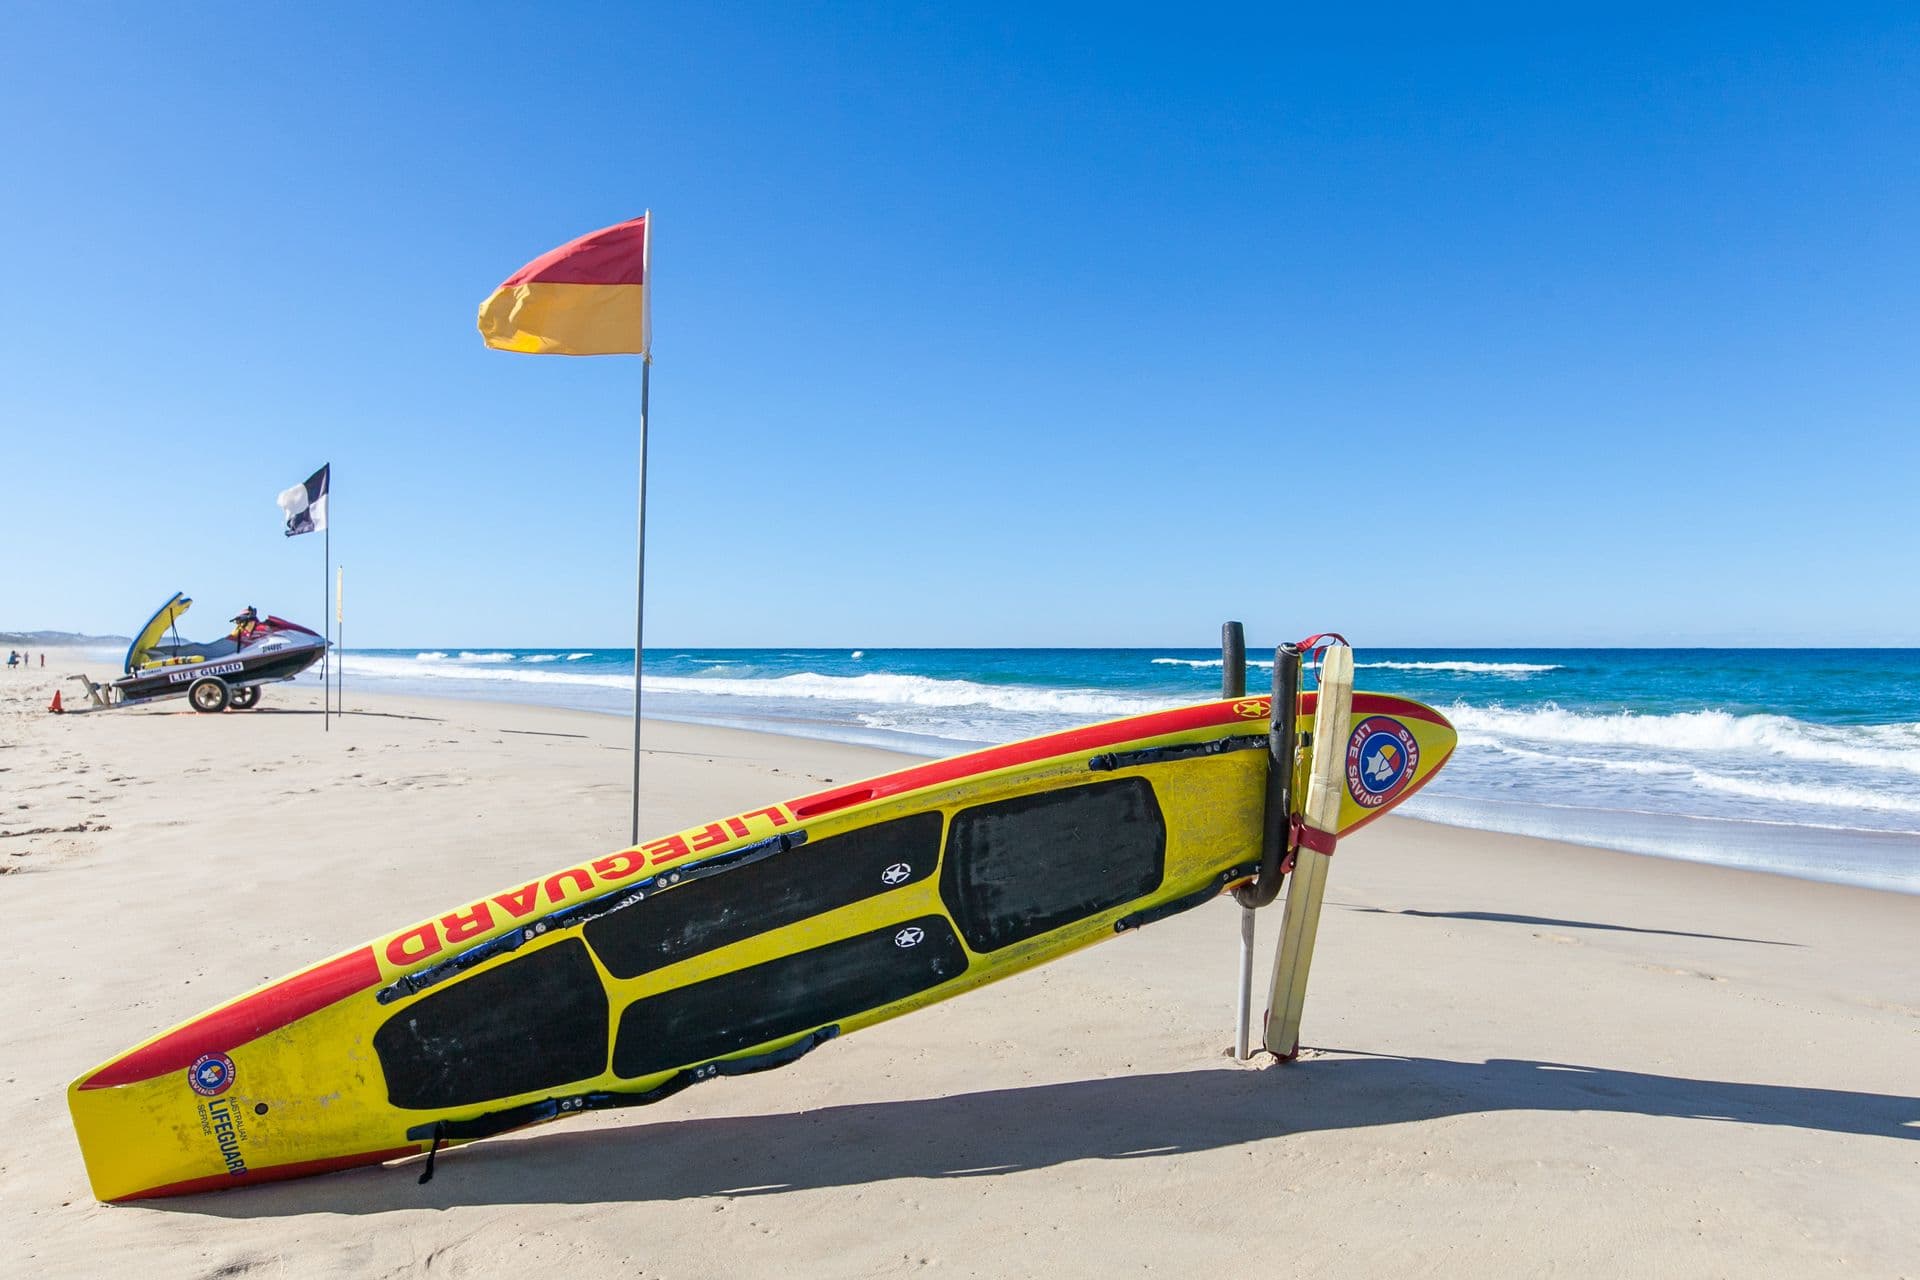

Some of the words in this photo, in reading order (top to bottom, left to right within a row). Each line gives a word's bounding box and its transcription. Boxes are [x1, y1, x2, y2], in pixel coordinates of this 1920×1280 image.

[171, 671, 197, 682] LIFE
[200, 663, 241, 677] GUARD
[1349, 723, 1372, 759] LIFE
[1398, 729, 1418, 780] SURF
[1348, 765, 1383, 805] SAVING
[385, 806, 789, 967] LIFEGUARD
[190, 1054, 209, 1072] LIFE
[223, 1057, 234, 1084] SURF
[189, 1073, 216, 1096] SAVING
[197, 1104, 212, 1137] SERVICE
[229, 1096, 248, 1142] AUSTRALIAN
[208, 1098, 248, 1177] LIFEGUARD
